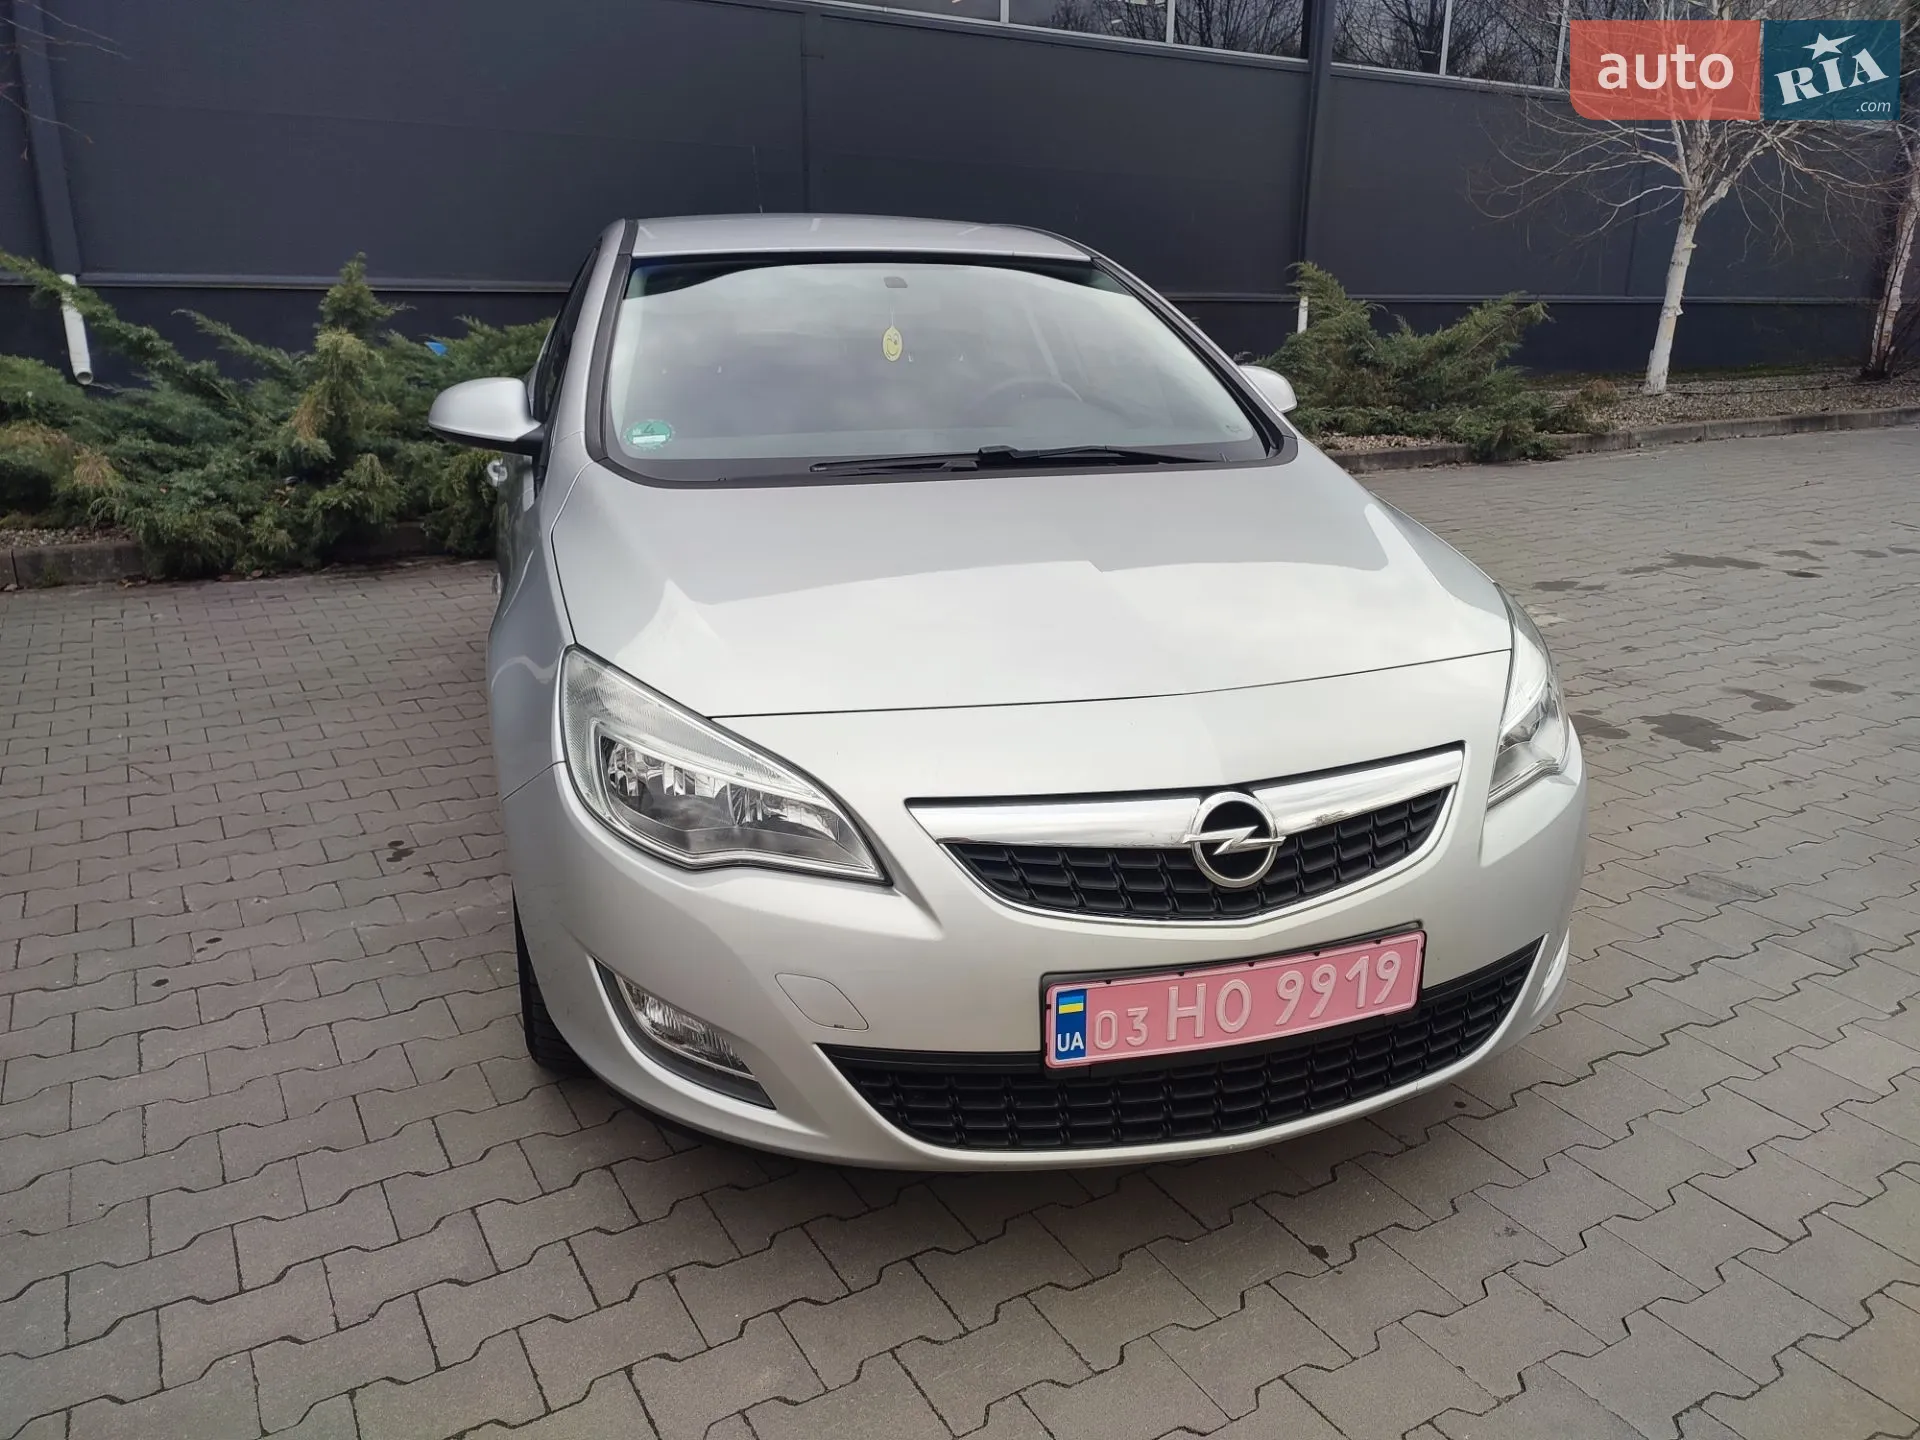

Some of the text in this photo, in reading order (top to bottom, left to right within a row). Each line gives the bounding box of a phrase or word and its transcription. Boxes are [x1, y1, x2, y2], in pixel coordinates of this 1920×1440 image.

[1093, 950, 1403, 1050] 03 HO 9919
[1057, 1032, 1084, 1052] UA
